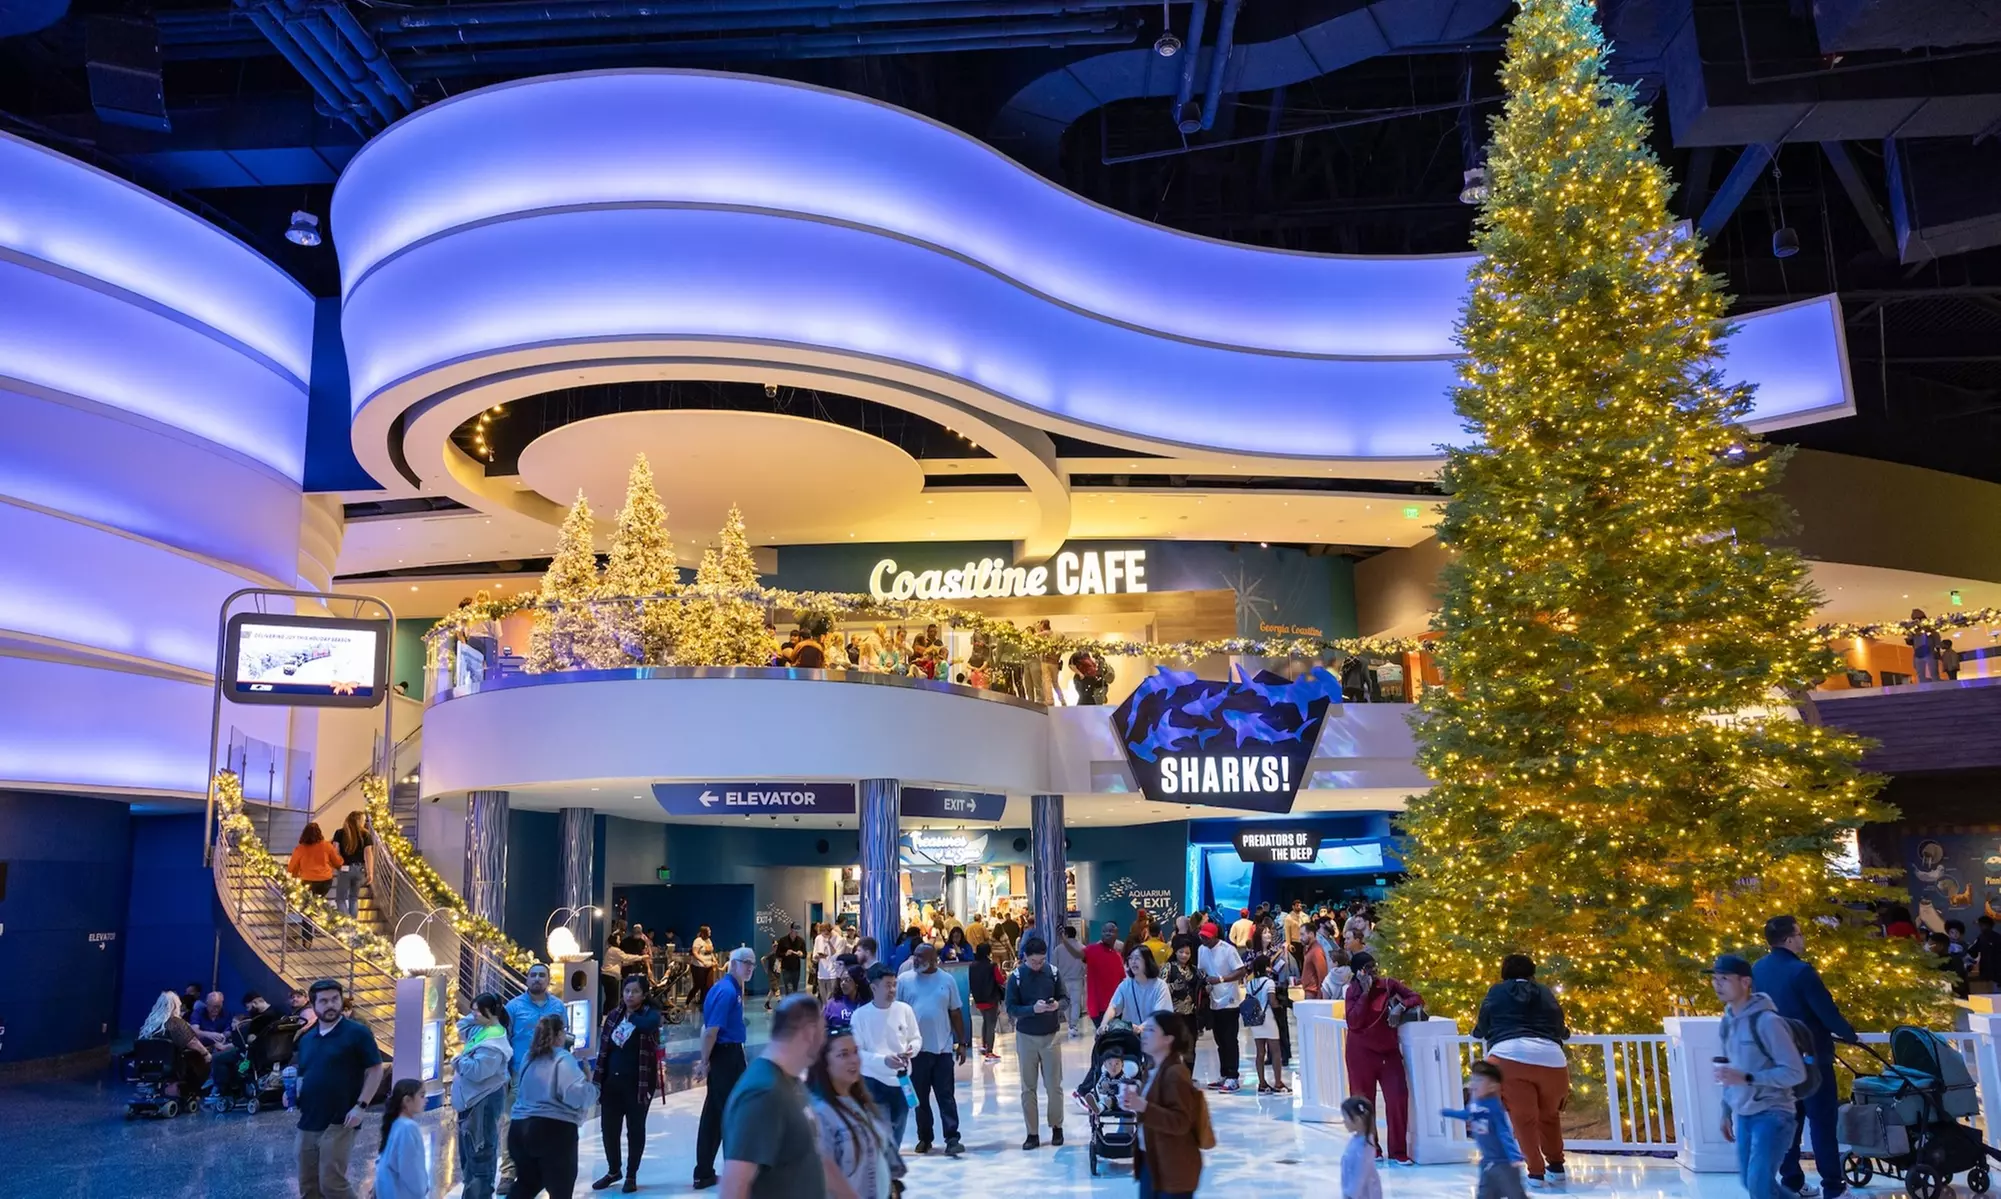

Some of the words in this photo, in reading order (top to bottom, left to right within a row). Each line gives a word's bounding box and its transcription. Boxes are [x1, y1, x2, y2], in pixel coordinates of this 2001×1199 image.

[869, 558, 1048, 600] Coastline
[1056, 550, 1148, 595] CAFE
[1260, 621, 1289, 635] Georgia
[1161, 756, 1290, 793] SHARKS!
[726, 792, 815, 806] ELEVATOR
[944, 798, 965, 811] EXIT
[910, 831, 968, 852] Treasures
[1243, 833, 1294, 847] PREDATORS
[1296, 833, 1307, 845] OF
[1271, 849, 1289, 860] THE
[1291, 848, 1312, 860] DEEP
[1129, 890, 1171, 898] AQUARIUM
[1144, 898, 1170, 908] EXIT
[756, 916, 768, 924] EXIT
[88, 933, 116, 942] ELEVATOR
